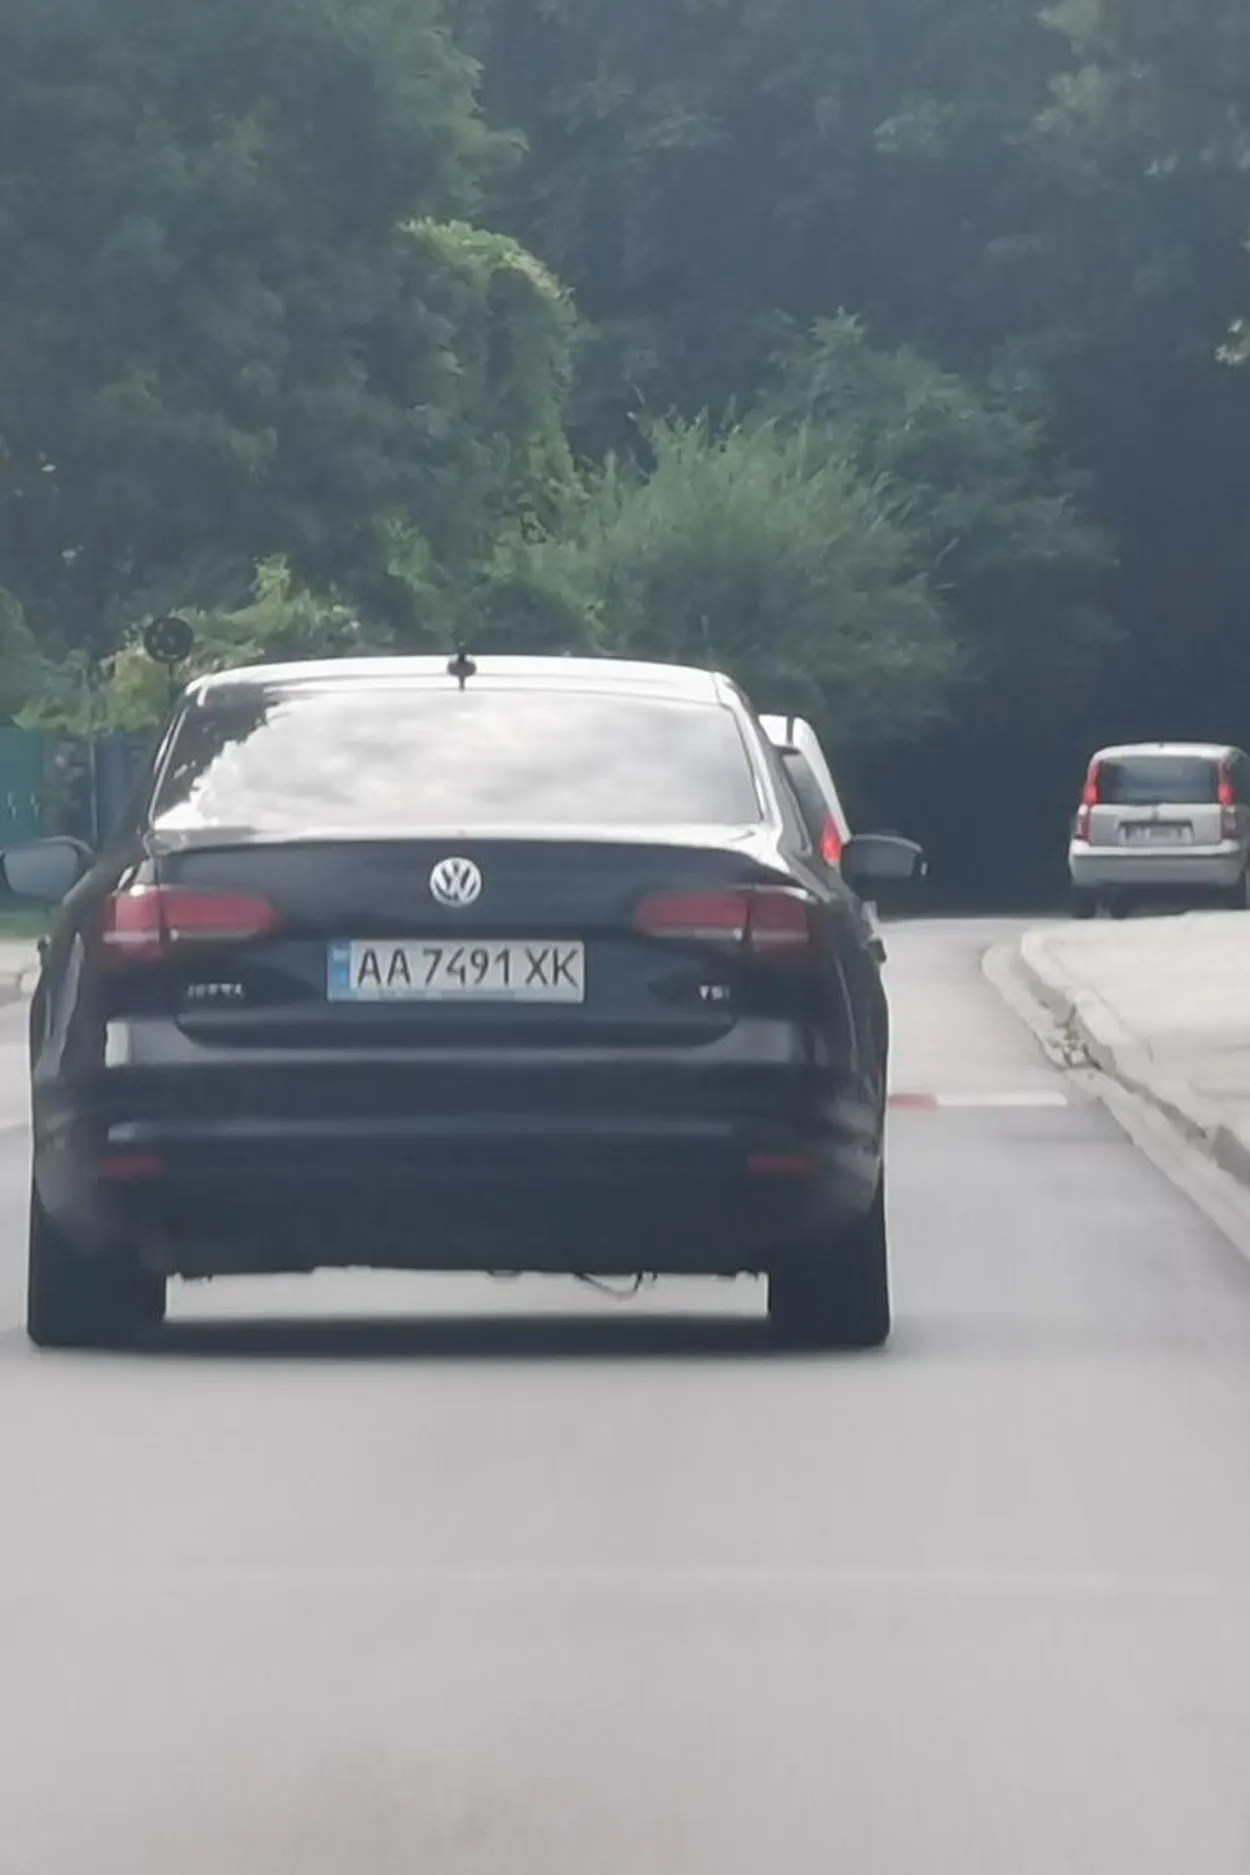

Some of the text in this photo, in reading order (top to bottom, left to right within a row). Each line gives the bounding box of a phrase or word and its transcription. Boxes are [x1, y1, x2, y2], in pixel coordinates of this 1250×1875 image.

[356, 945, 579, 987] AA 7491 XK
